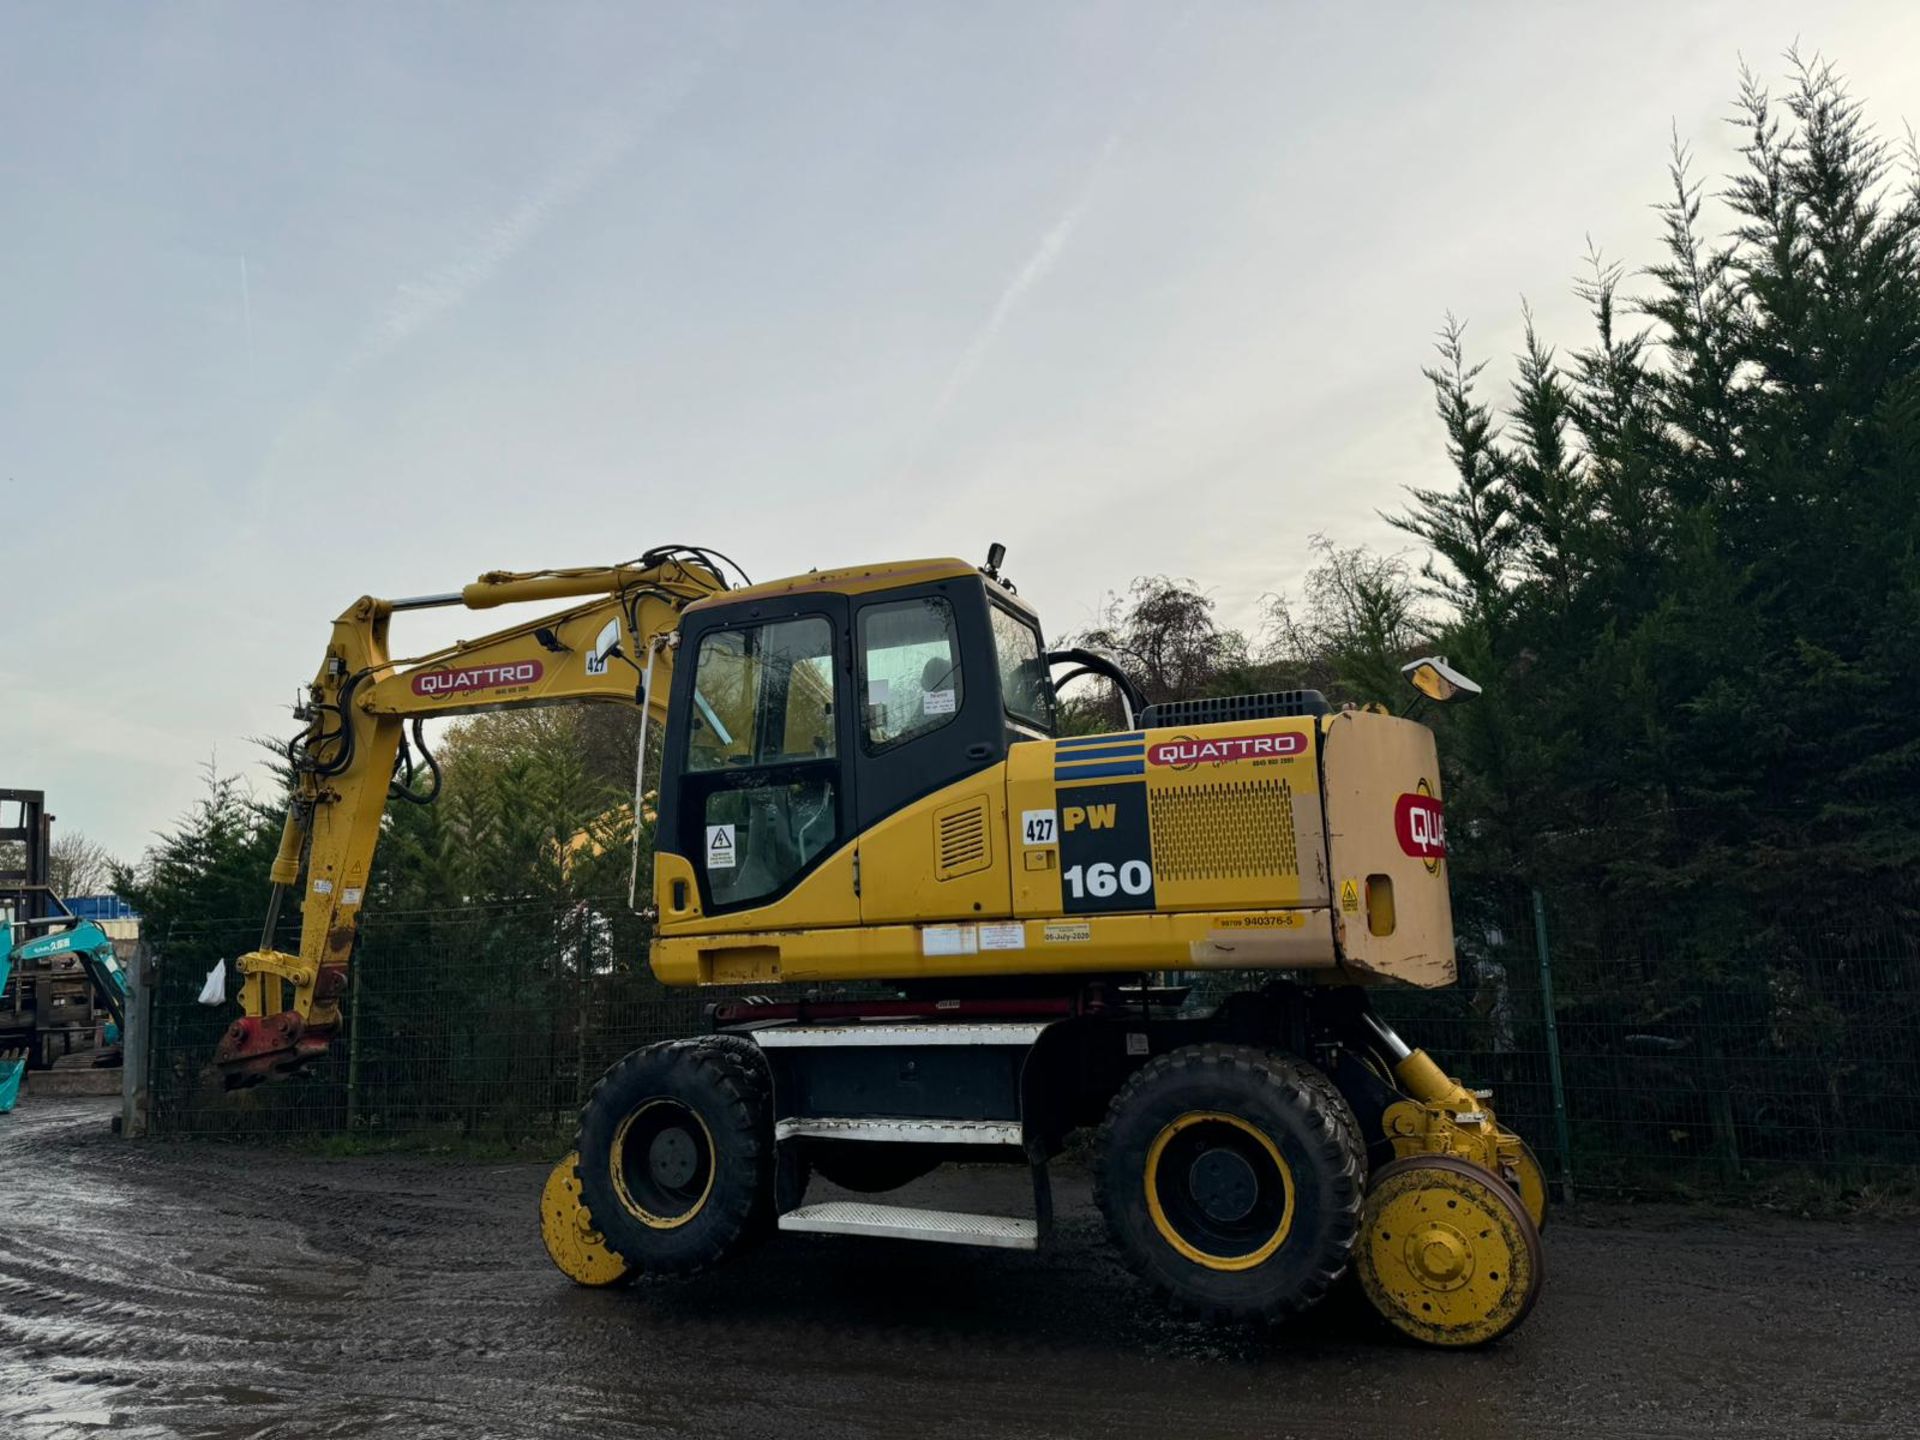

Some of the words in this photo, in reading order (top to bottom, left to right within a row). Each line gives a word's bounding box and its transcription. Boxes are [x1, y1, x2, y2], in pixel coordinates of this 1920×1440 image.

[420, 664, 534, 693] QUATTRO
[1158, 736, 1296, 763] QUATTRO
[1026, 819, 1053, 842] 427
[1062, 803, 1117, 832] PW
[1063, 859, 1153, 899] 160
[1244, 915, 1294, 927] 940376-5
